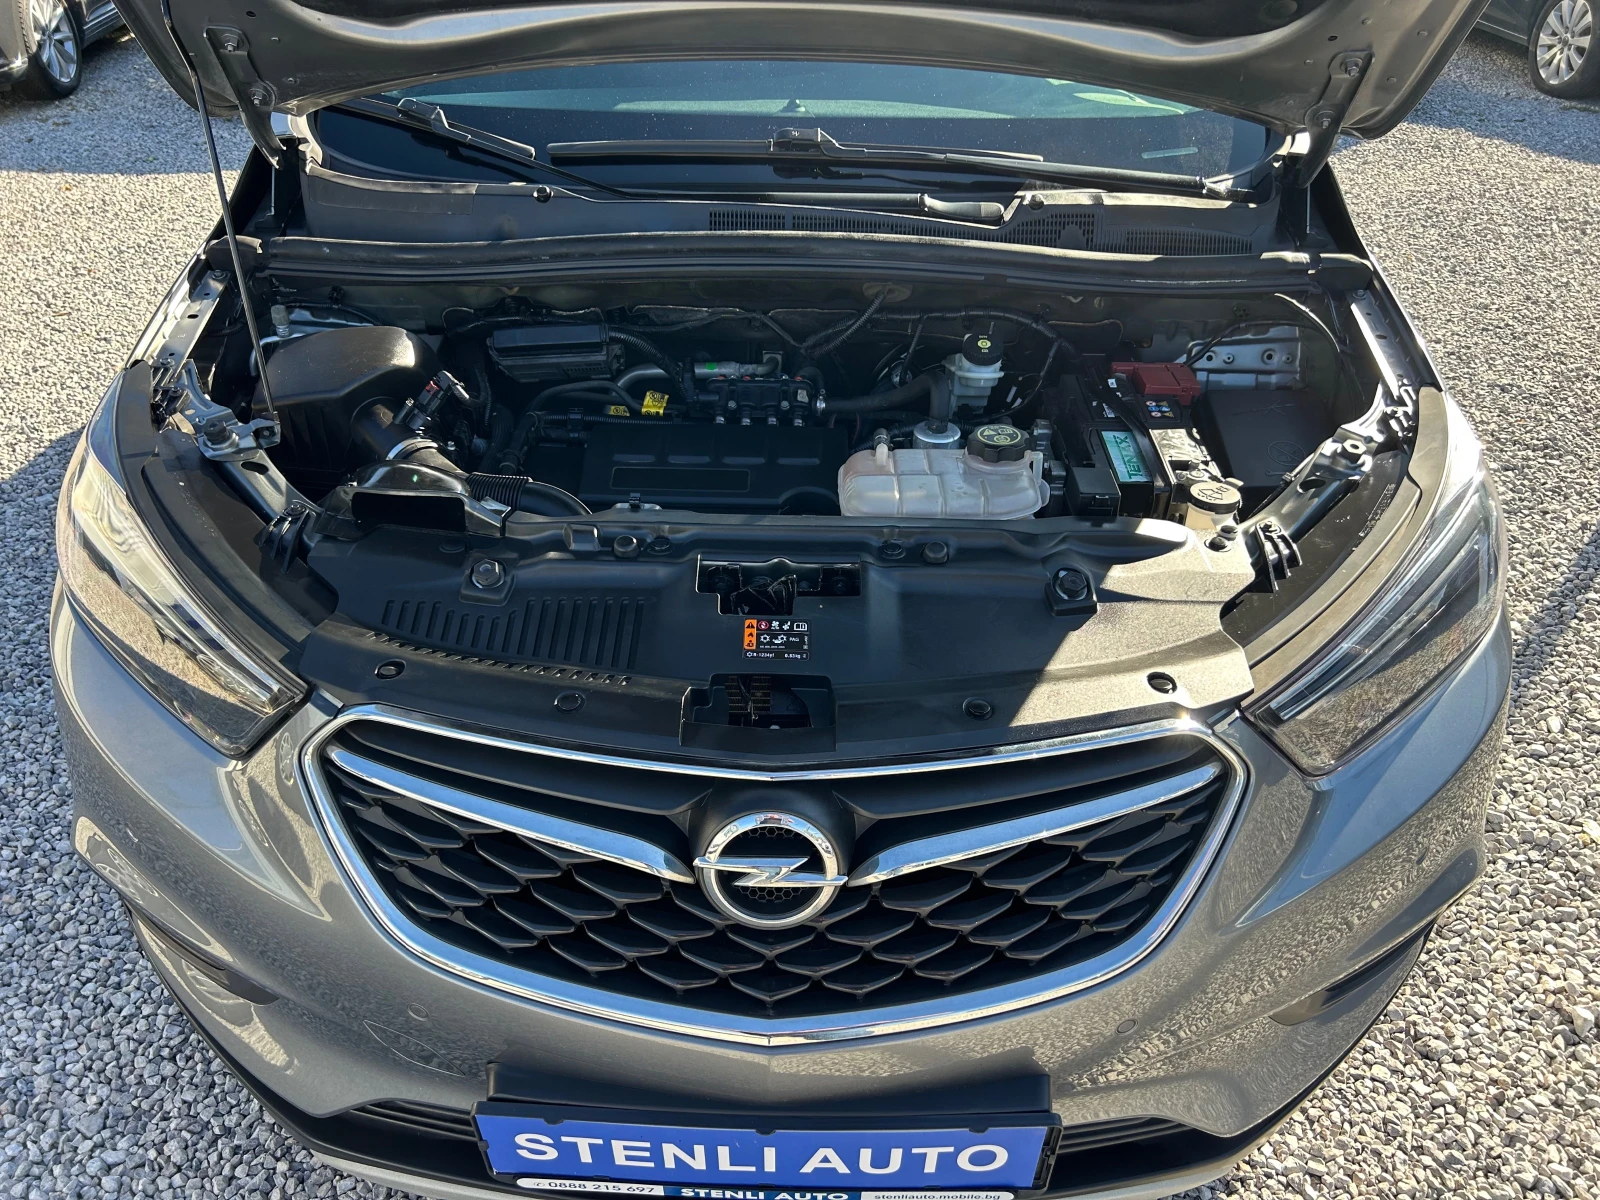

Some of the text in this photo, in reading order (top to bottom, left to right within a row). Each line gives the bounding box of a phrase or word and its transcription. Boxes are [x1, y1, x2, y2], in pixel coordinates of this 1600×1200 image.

[514, 1133, 1009, 1175] STENLI AUTO
[548, 1181, 588, 1190] 0888
[592, 1184, 621, 1192] 215
[681, 1188, 849, 1200] STENLI AUTO
